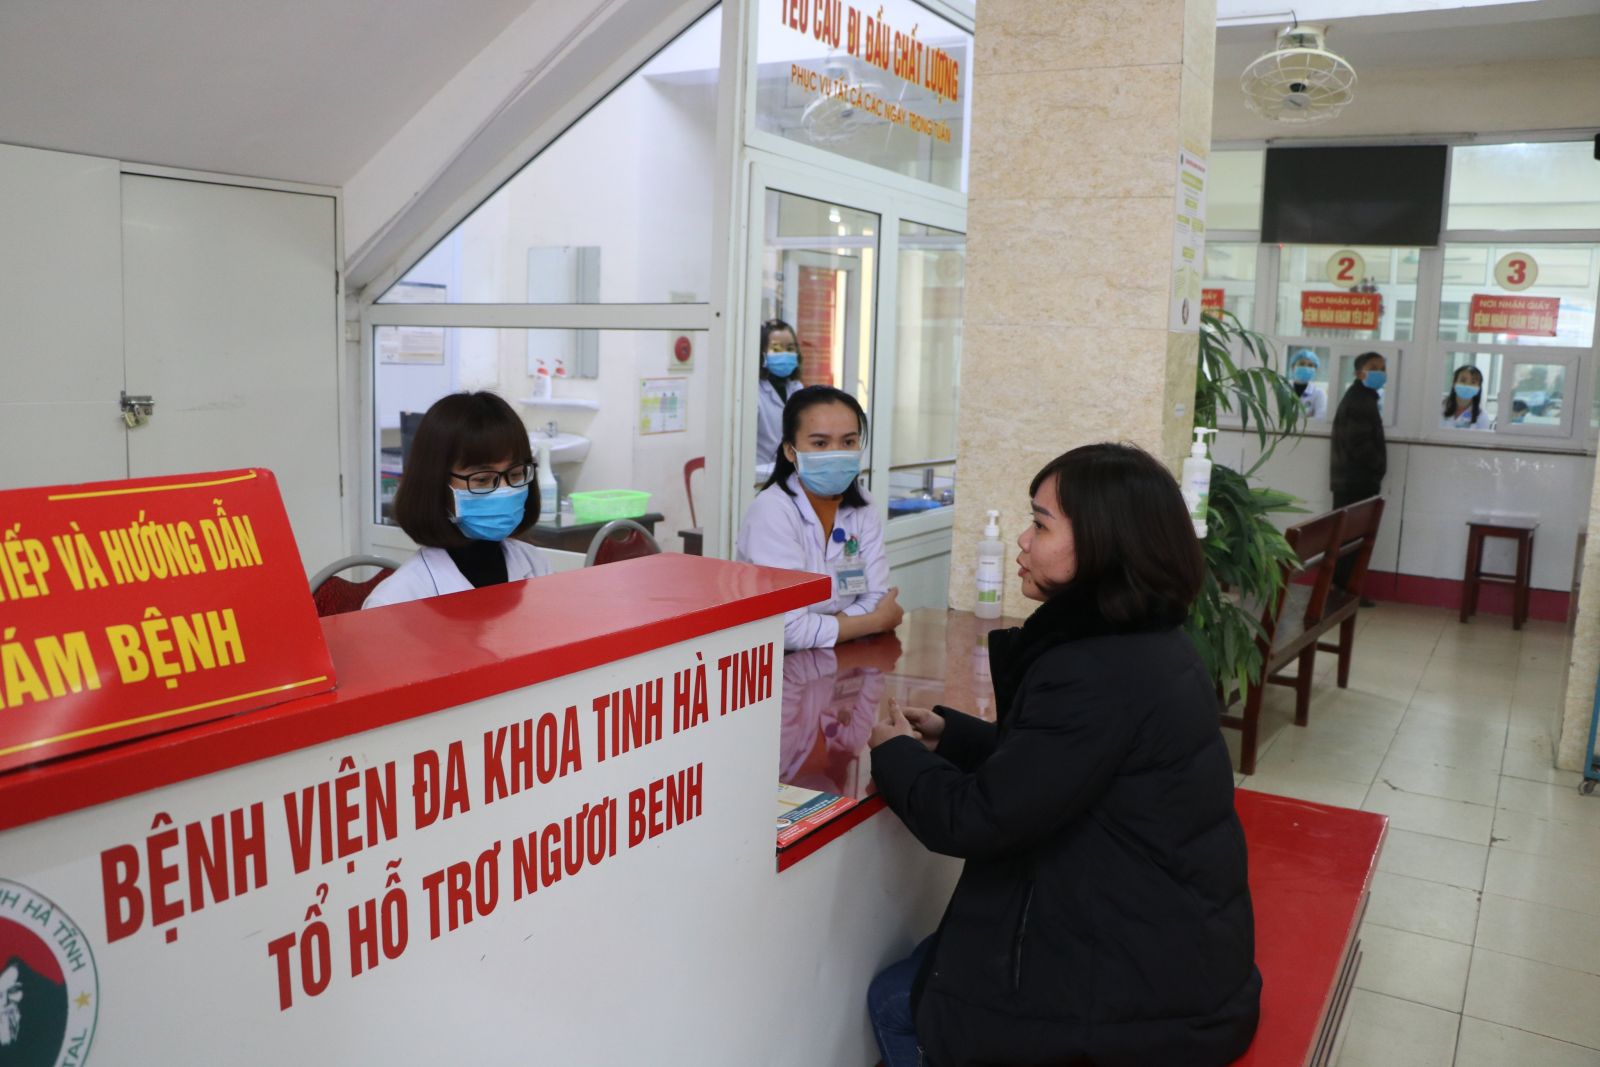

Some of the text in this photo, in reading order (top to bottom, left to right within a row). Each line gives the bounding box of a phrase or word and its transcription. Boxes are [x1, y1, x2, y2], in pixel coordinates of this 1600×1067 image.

[791, 63, 817, 93] PHỤC
[893, 23, 924, 85] CHẤT
[925, 45, 959, 104] LƯỢNG
[1337, 257, 1355, 281] 2
[1506, 259, 1527, 285] 3
[0, 497, 263, 602] IẾP VÀ HƯỚNG DẪN
[0, 606, 246, 710] ÁM BỆNH
[100, 641, 774, 944] BỆNH VIỆN ĐA KHOA TINH HÀ TINH
[268, 882, 333, 1012] TỔ
[347, 857, 409, 978] HỖ
[422, 840, 501, 941] TRƠ
[512, 795, 618, 902] NGƯƠI
[628, 761, 703, 849] BENH
